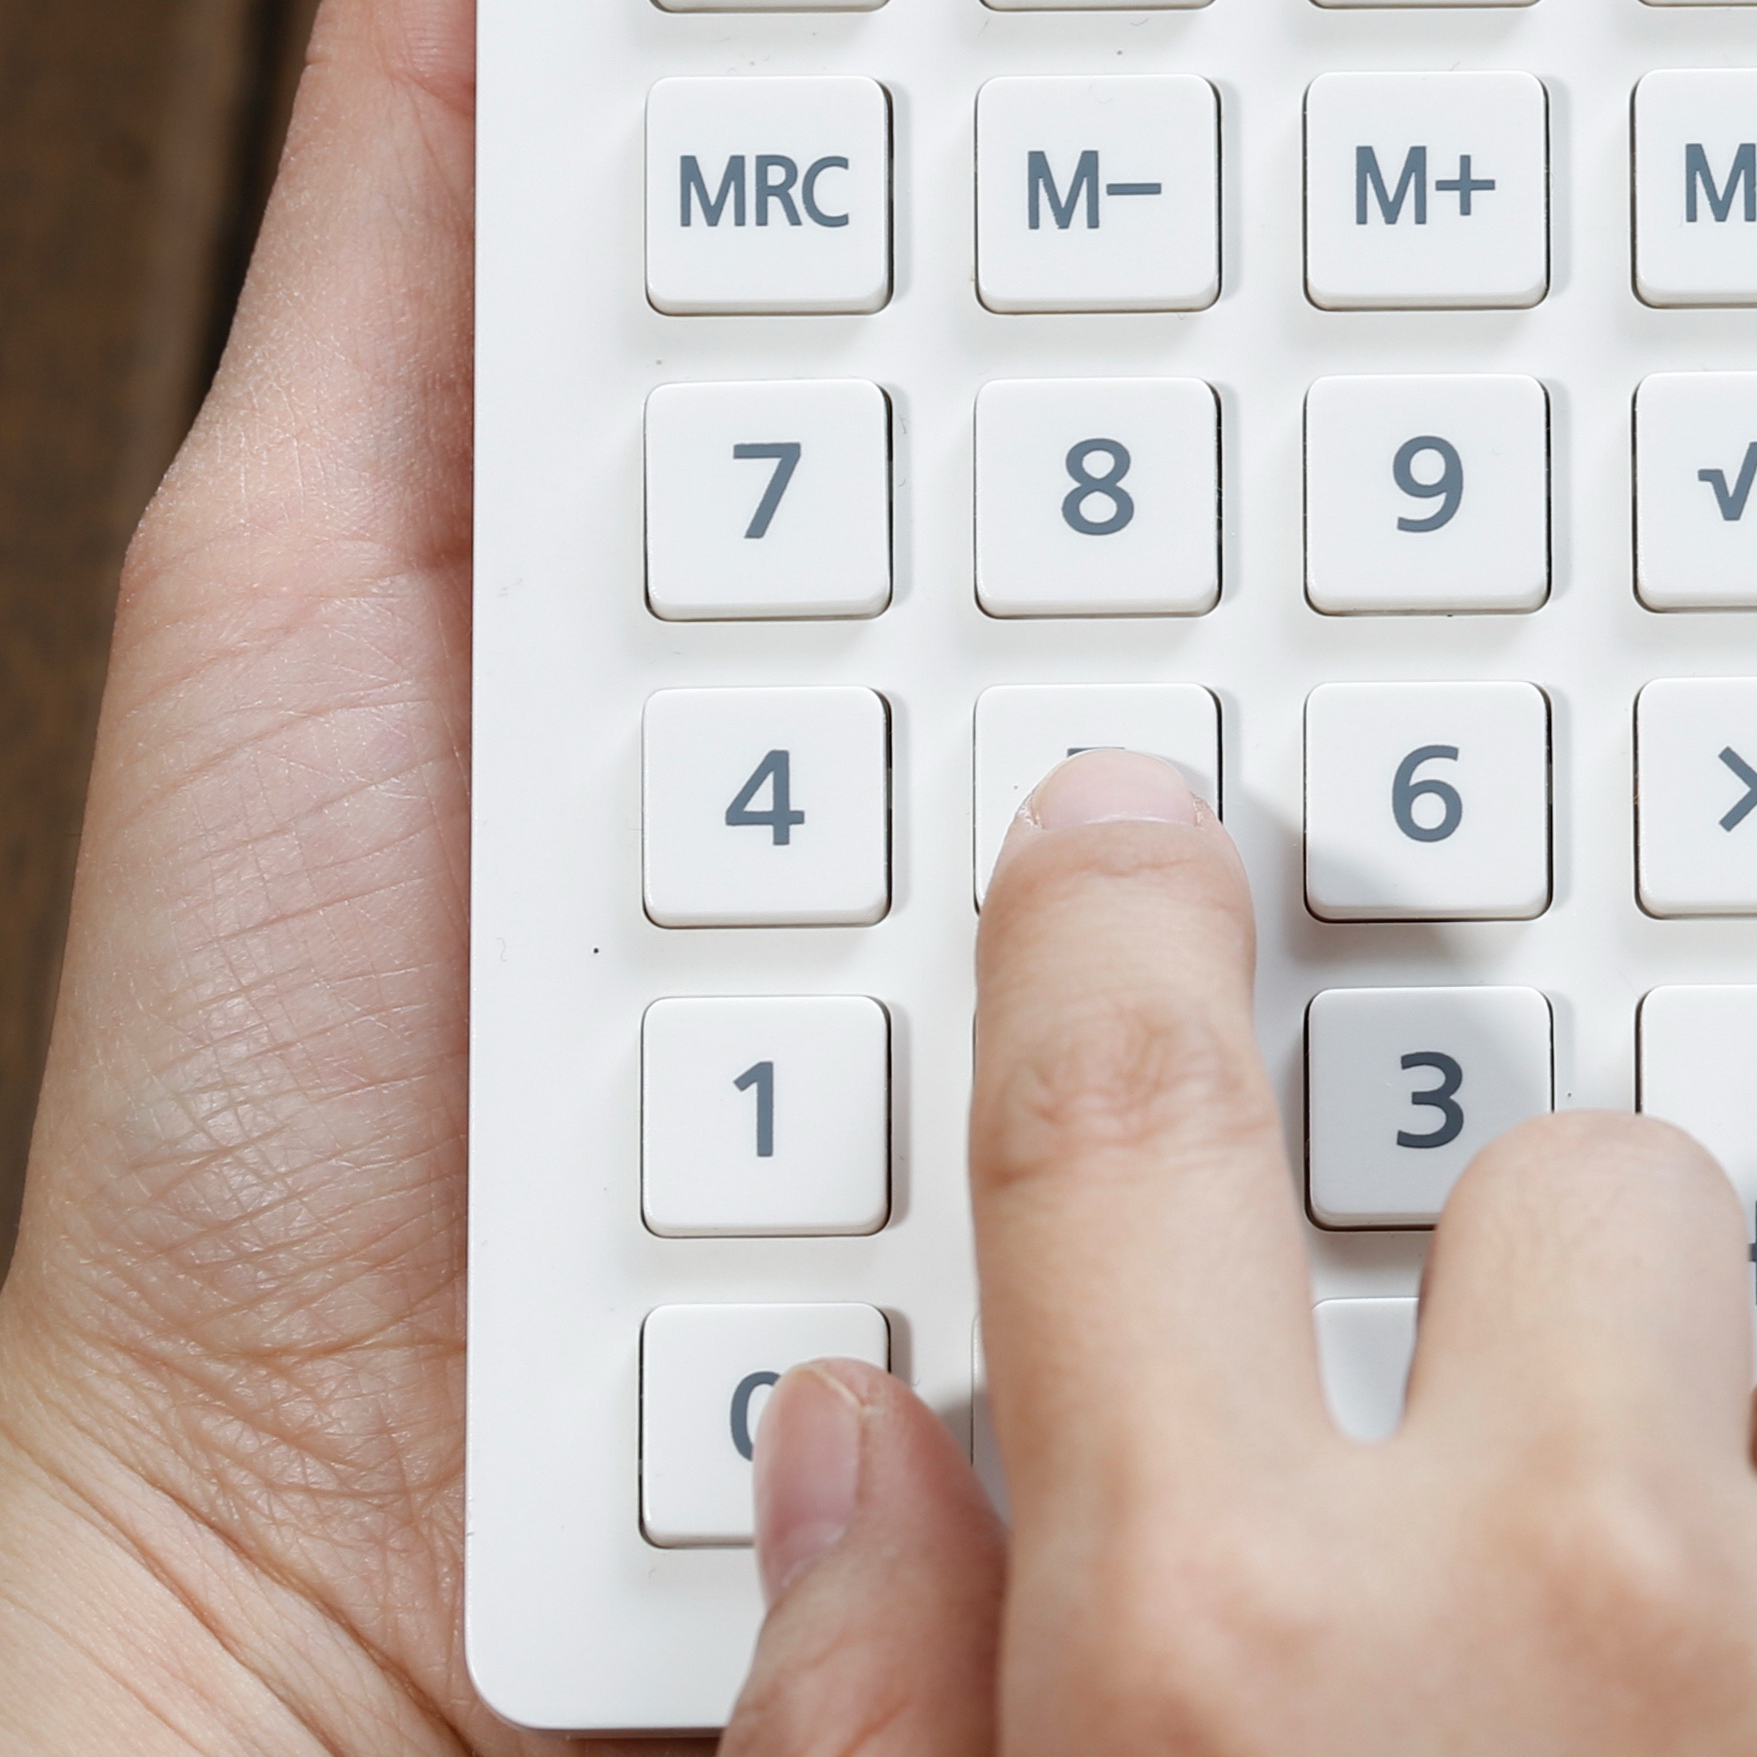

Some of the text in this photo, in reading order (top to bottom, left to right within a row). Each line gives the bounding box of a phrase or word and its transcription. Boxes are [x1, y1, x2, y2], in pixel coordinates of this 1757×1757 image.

[679, 154, 850, 228] MRC
[1355, 145, 1496, 226] M+
[732, 441, 802, 540] 7
[1060, 437, 1135, 537] 8
[1392, 435, 1464, 534] 9
[724, 749, 806, 847] 4
[1391, 744, 1463, 843] 6
[732, 1060, 775, 1158] 1
[1396, 1051, 1465, 1150] 3
